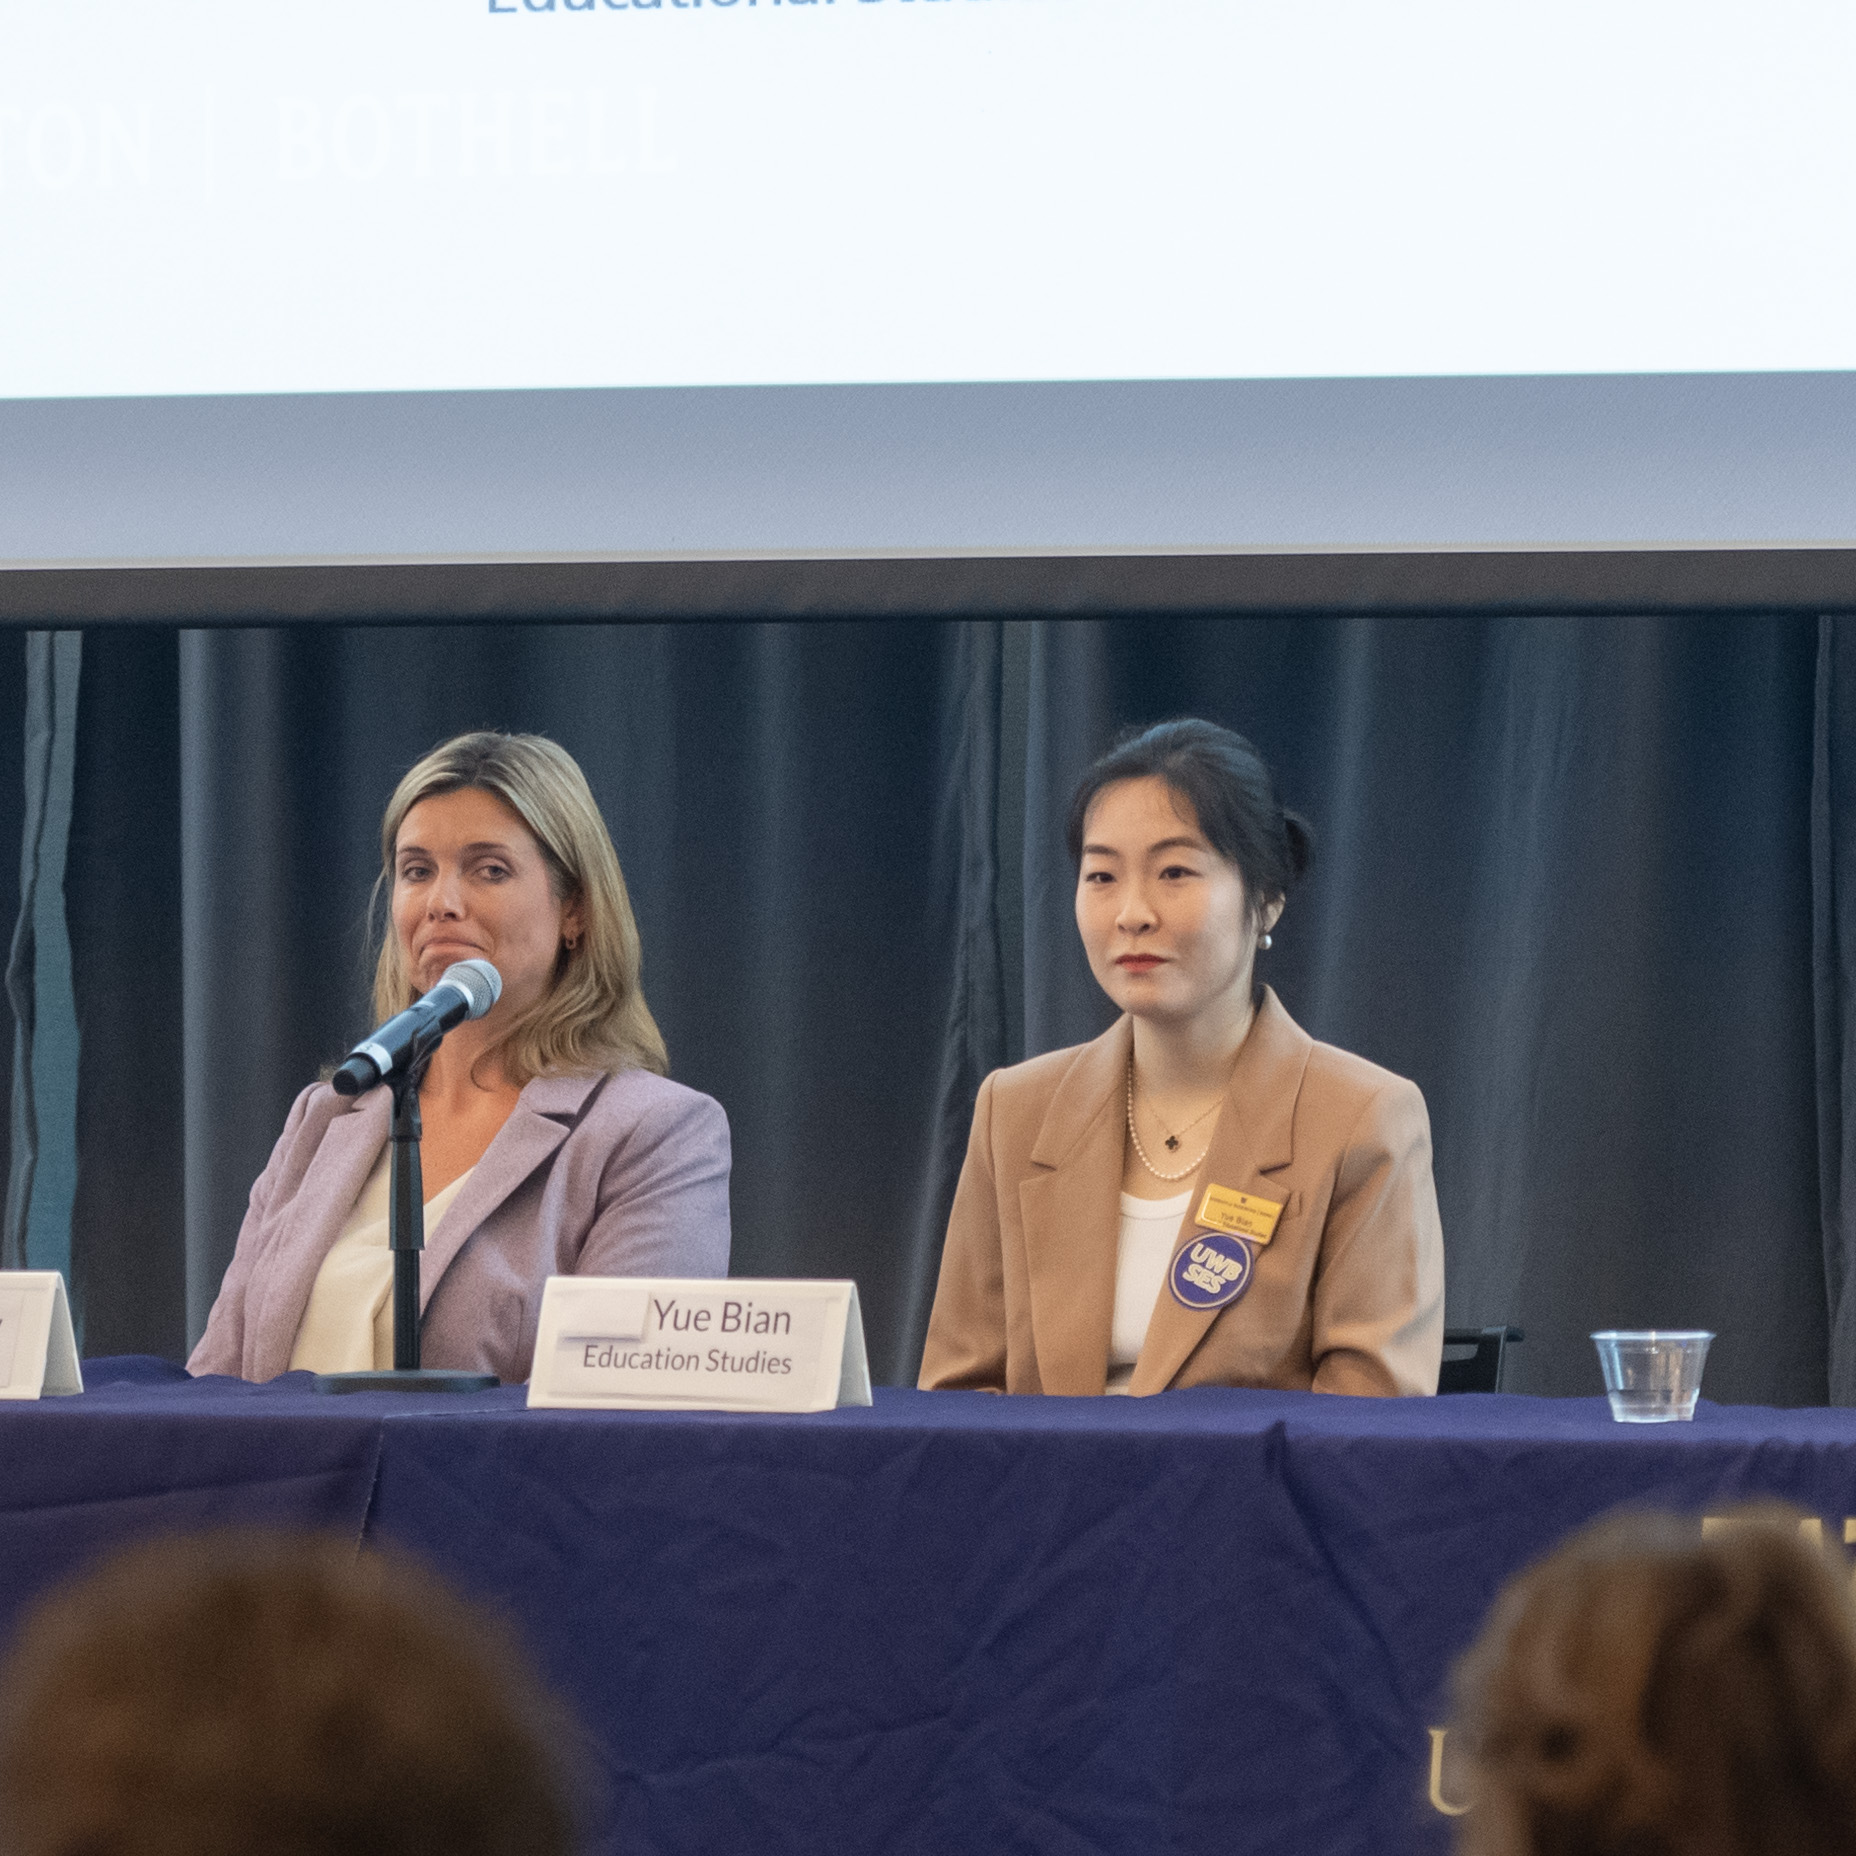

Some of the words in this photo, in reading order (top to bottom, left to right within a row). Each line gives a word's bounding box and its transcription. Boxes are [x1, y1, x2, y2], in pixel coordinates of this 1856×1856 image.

[276, 84, 679, 182] BOTHELL
[1182, 1263, 1226, 1294] SES
[1190, 1243, 1243, 1281] UWB
[653, 1299, 712, 1332] Yue
[720, 1301, 792, 1335] Bian
[583, 1344, 700, 1371] Education
[705, 1348, 793, 1375] Studies
